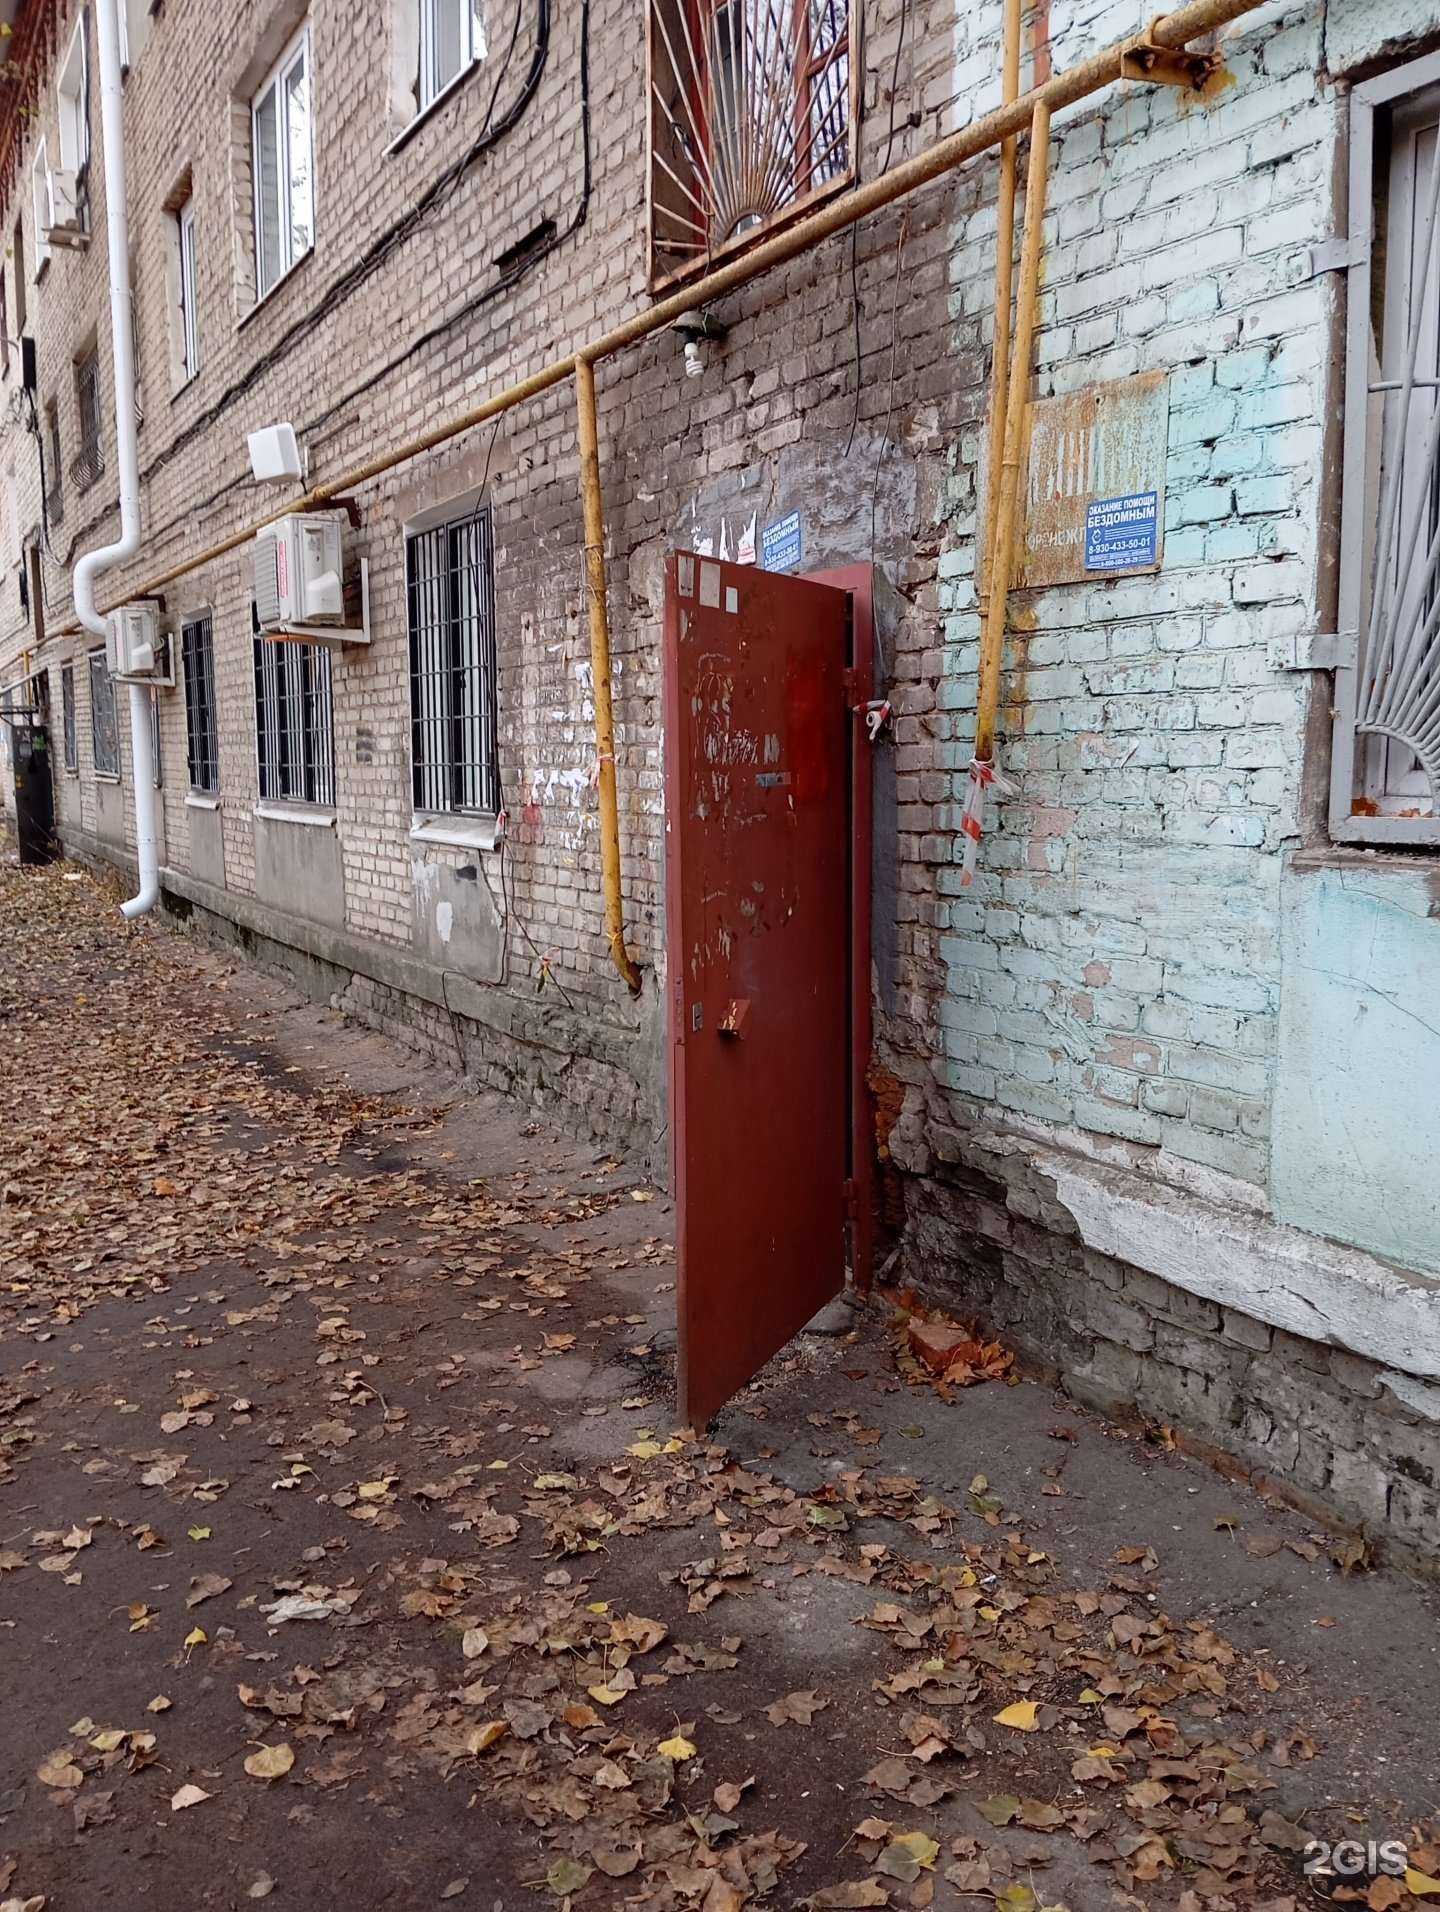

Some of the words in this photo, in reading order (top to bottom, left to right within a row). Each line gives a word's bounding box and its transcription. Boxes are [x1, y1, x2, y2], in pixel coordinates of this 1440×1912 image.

[1088, 501, 1123, 516] ОКАЗАНИЕ
[1123, 495, 1155, 509] ПОМОЩИ
[1087, 506, 1155, 528] БЕЗДОМНЫМ
[1088, 537, 1150, 554] 8-930-433-50-01
